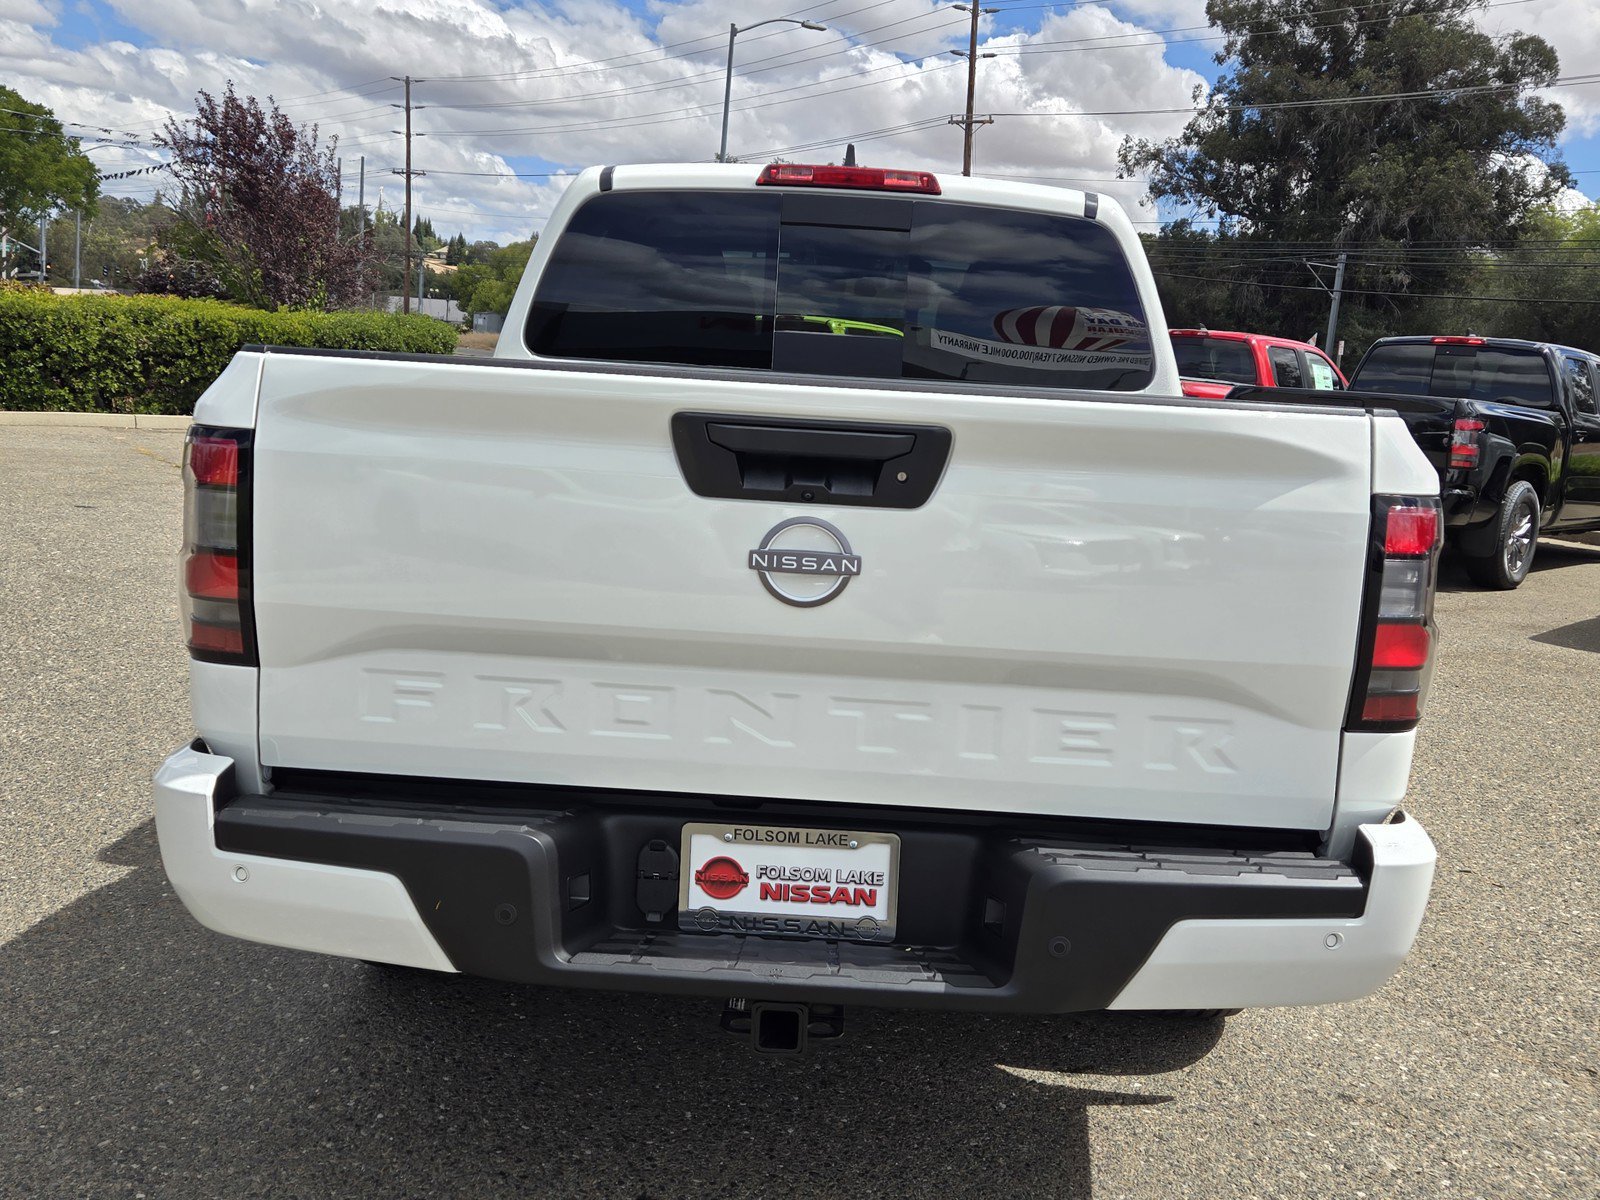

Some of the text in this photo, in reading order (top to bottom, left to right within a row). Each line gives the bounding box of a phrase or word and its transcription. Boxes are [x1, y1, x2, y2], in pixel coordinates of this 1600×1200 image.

[752, 553, 858, 572] NISSAN
[360, 667, 1238, 774] FRONTIER
[733, 828, 848, 847] FOLSOM LAKE
[694, 871, 750, 884] NISSAN
[756, 864, 884, 886] FOLSOM LAKE
[759, 881, 877, 907] NISSAN
[728, 914, 846, 937] NISSAN
